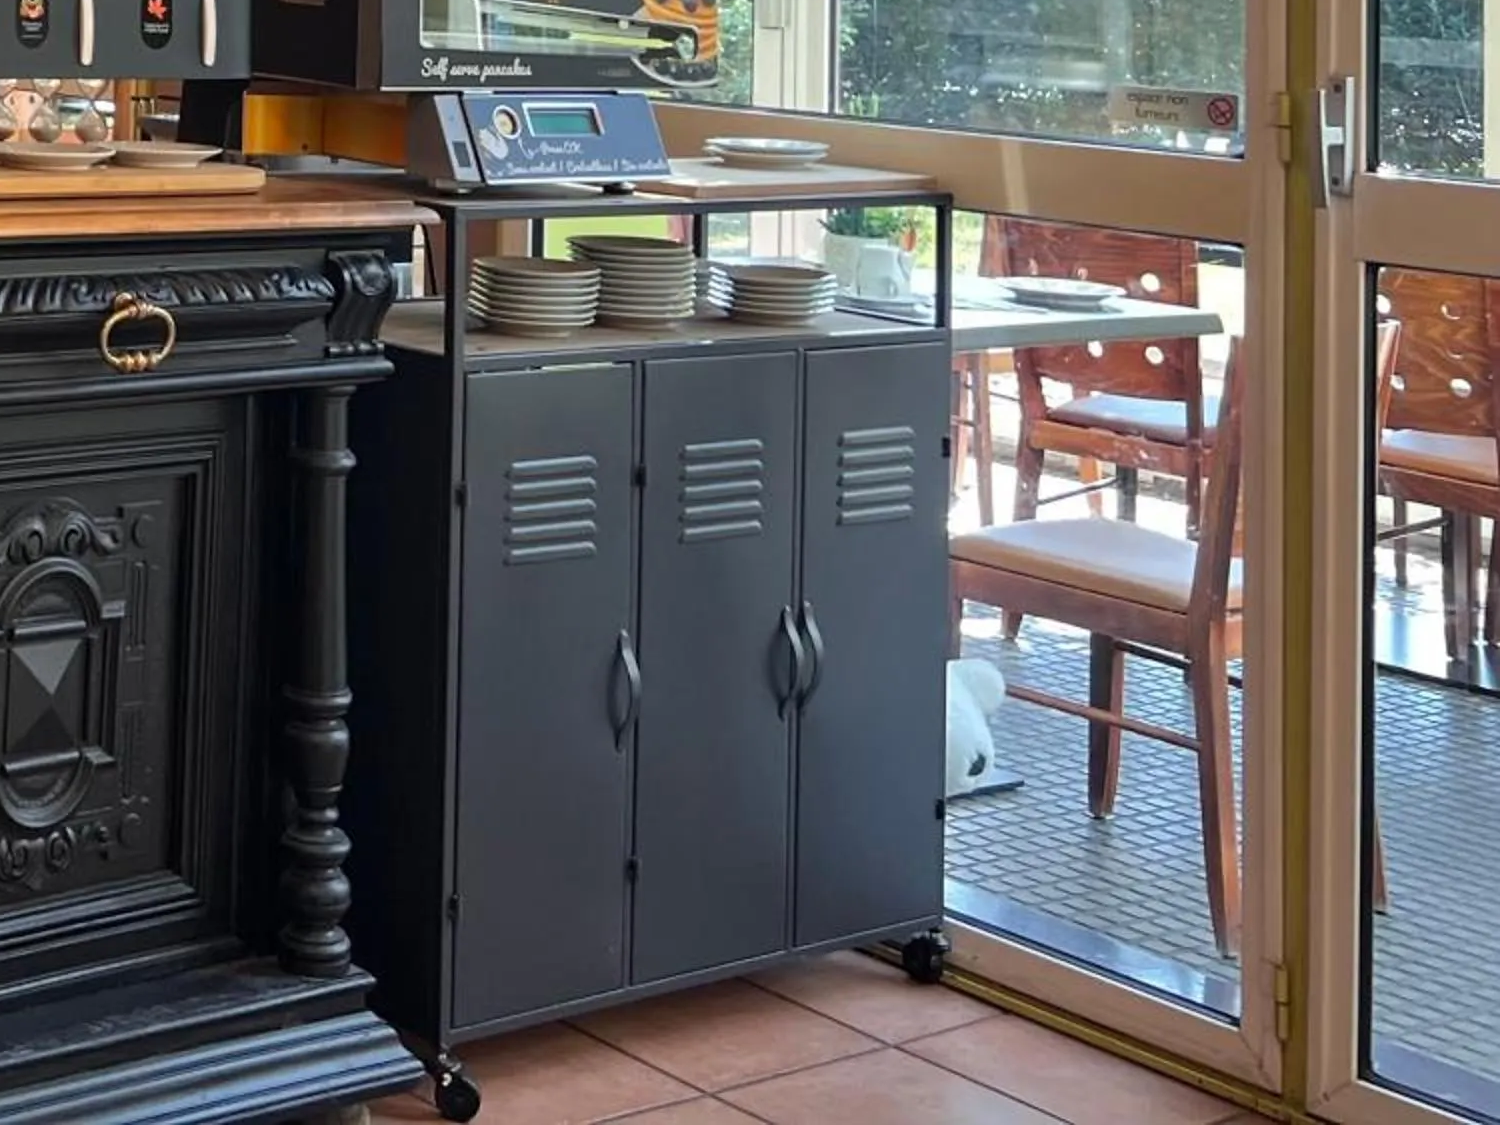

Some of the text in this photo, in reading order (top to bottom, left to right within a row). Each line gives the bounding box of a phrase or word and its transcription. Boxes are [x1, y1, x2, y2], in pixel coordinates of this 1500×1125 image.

[421, 56, 533, 83] Self serve pancakes
[1165, 93, 1189, 105] non
